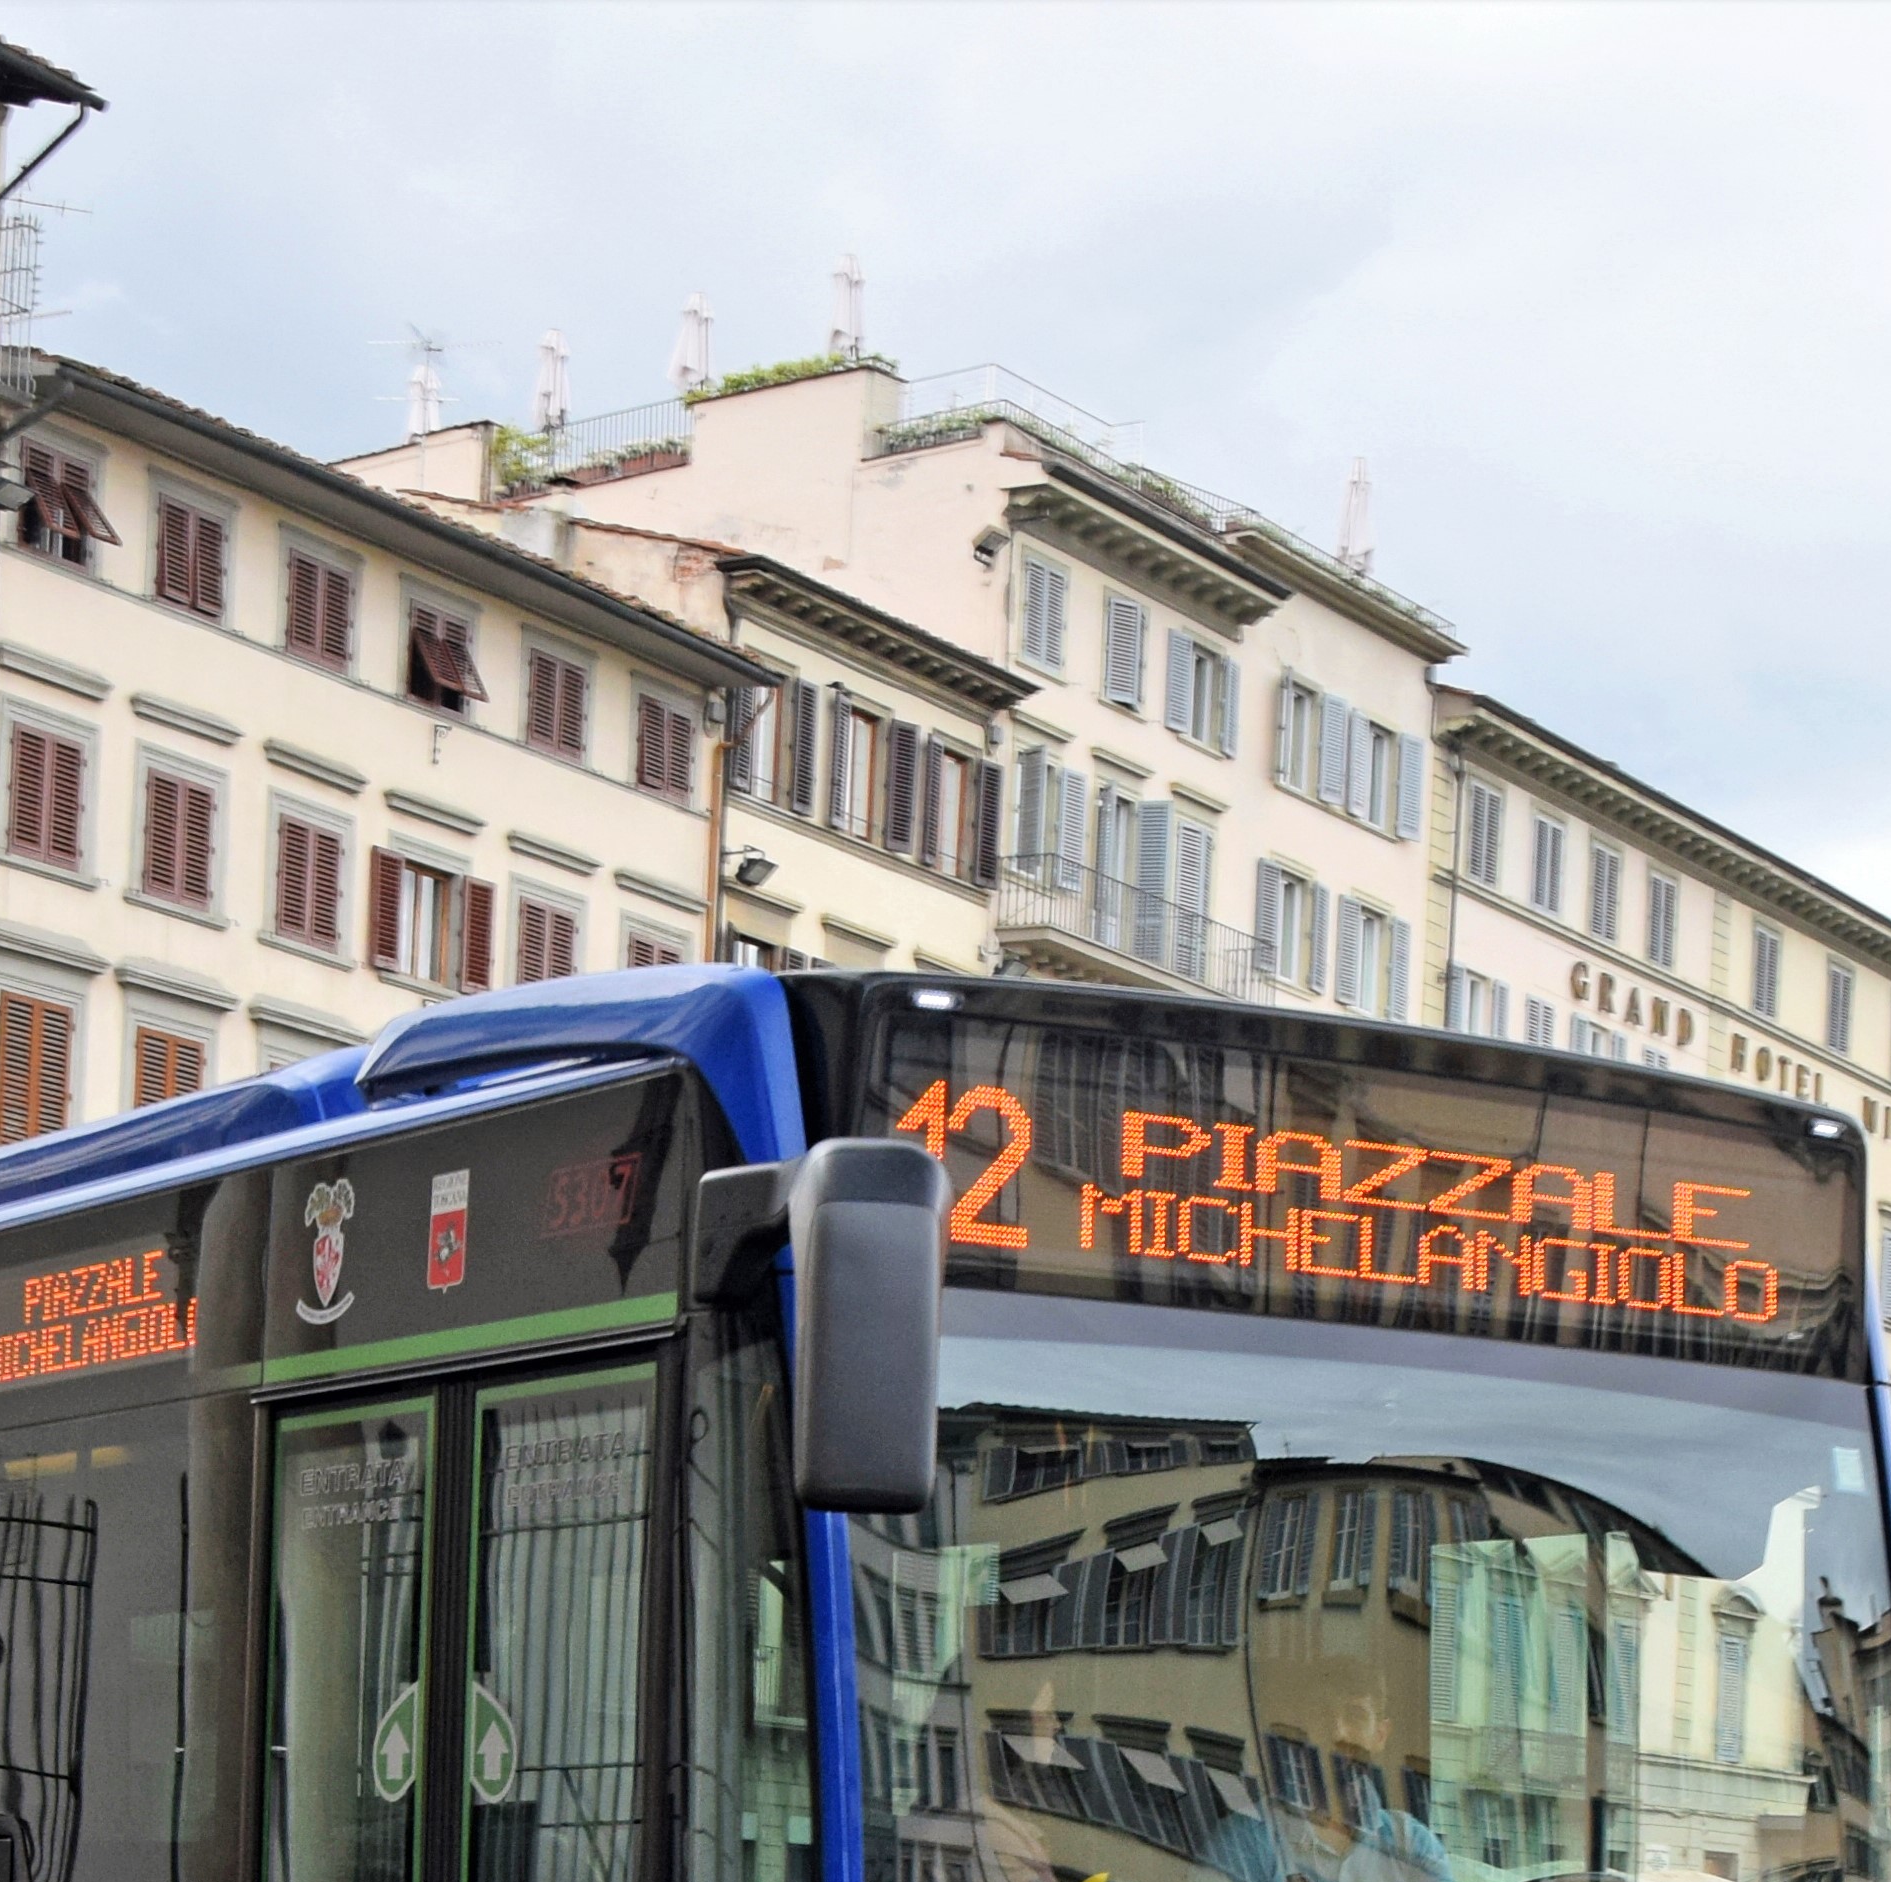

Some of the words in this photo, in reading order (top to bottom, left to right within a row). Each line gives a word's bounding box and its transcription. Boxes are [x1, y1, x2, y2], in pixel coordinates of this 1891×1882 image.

[1570, 961, 1694, 1046] GRAND
[1730, 1032, 1828, 1107] HOTEL
[896, 1079, 1031, 1249] 12
[1120, 1110, 1751, 1250] PIAZZALE
[23, 1249, 164, 1325] PIAZZALE
[1079, 1183, 1778, 1322] MICHELANGIOLO
[299, 1457, 408, 1497] ENTRATA
[505, 1430, 626, 1468] ENTRATA
[301, 1495, 403, 1530] ENTRANCE
